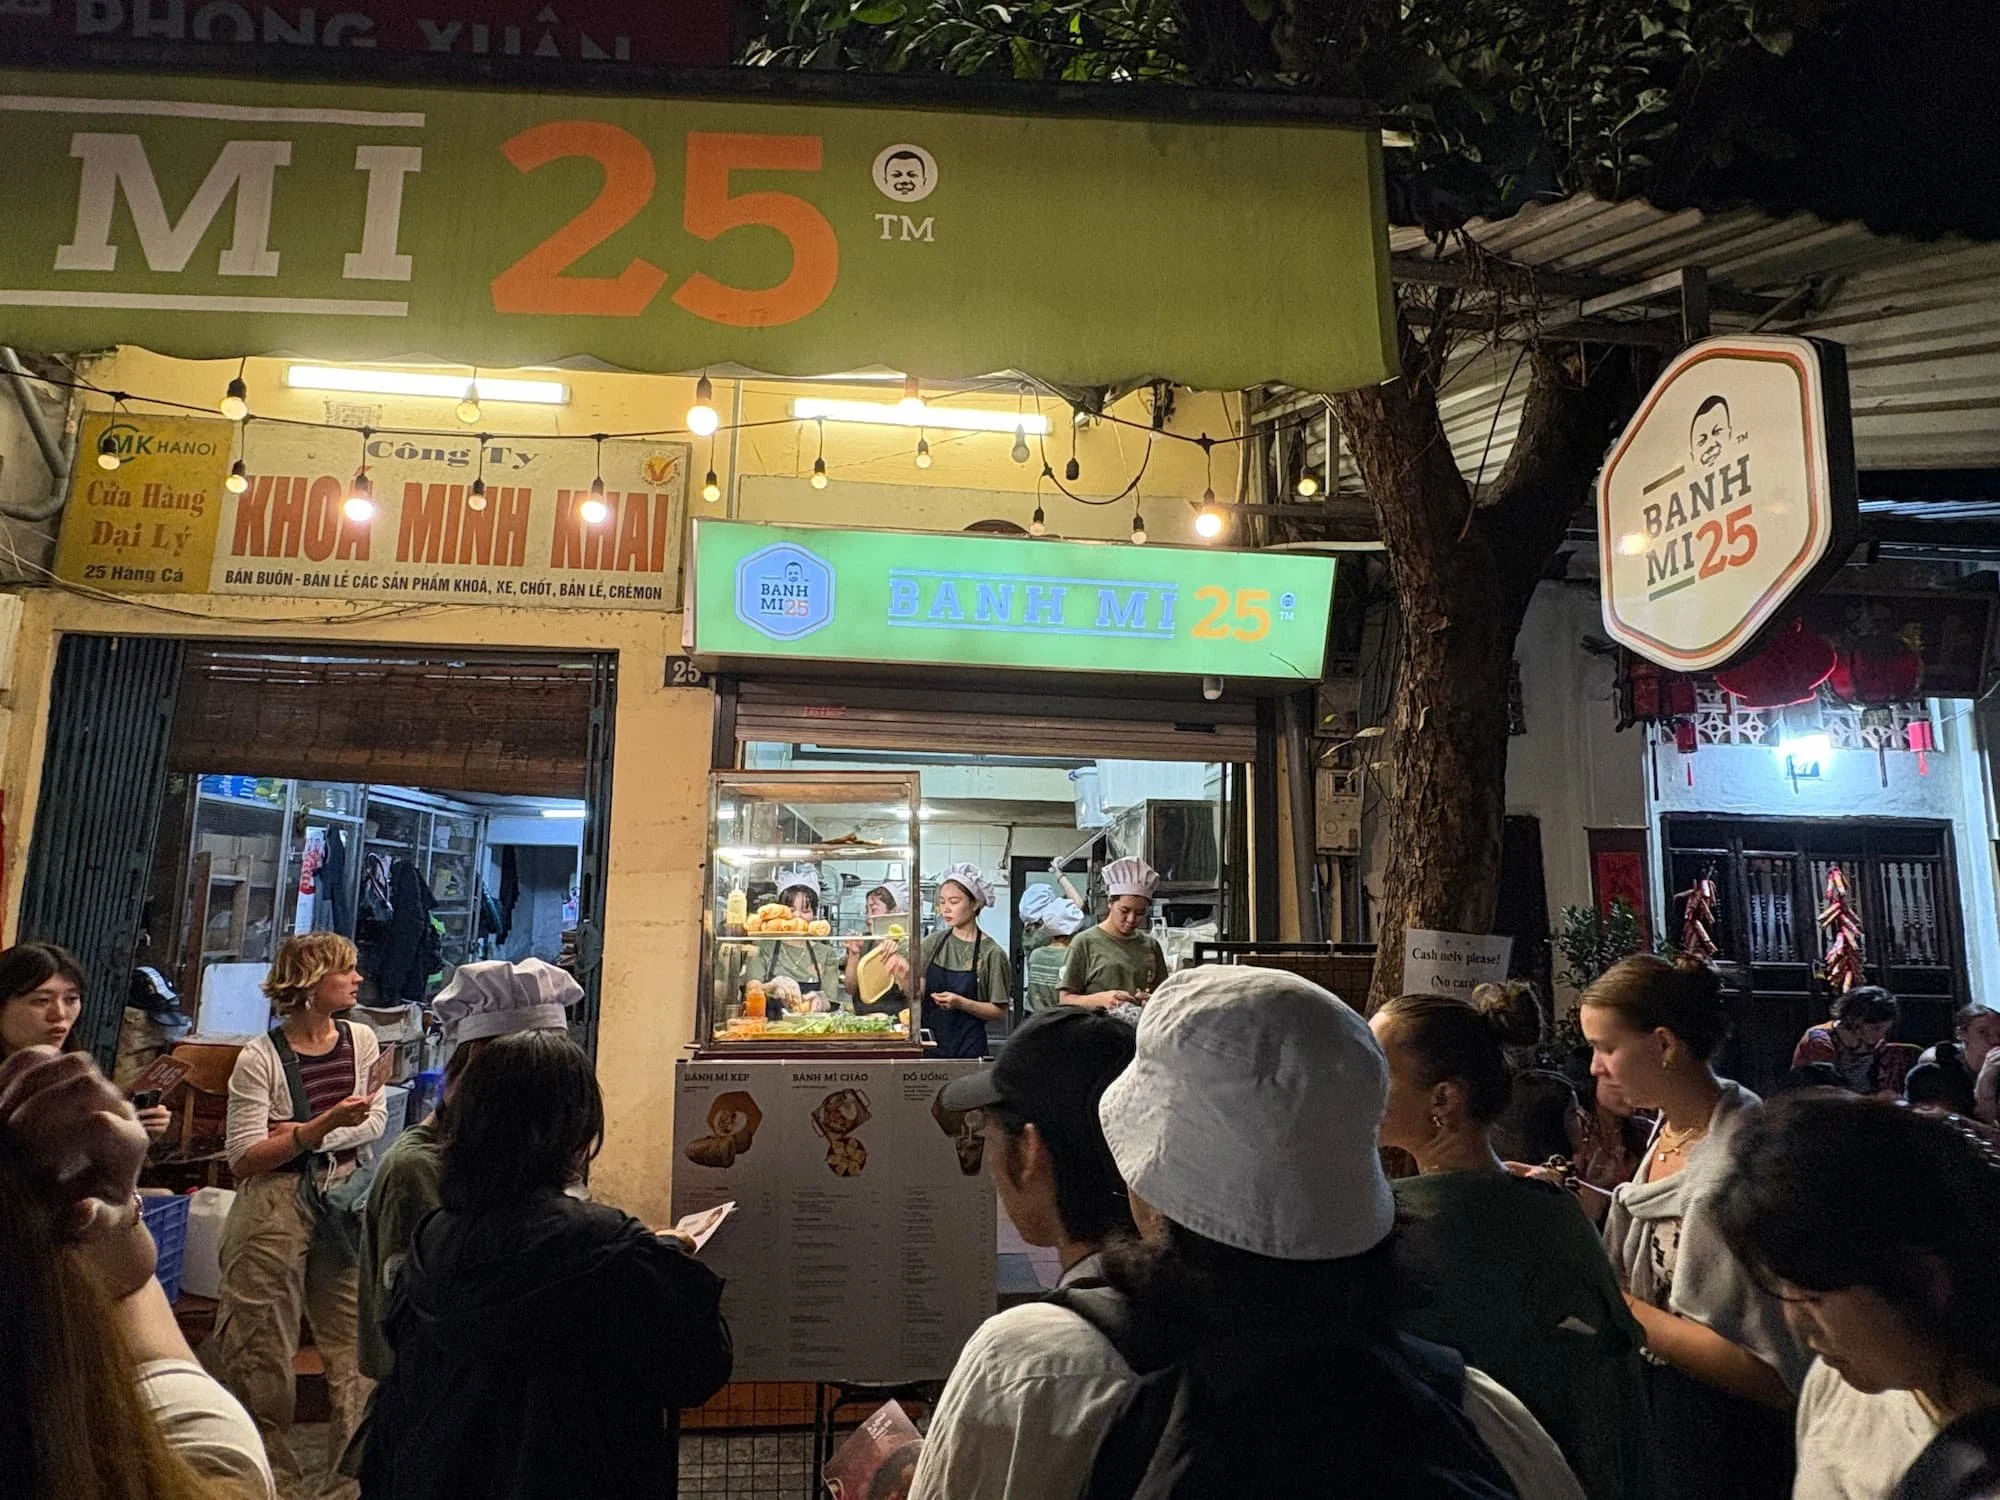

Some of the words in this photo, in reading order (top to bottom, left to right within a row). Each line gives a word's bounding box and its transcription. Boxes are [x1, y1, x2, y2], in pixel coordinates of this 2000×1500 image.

[53, 132, 422, 280] MI
[490, 119, 839, 327] 25
[874, 213, 935, 242] TM
[157, 440, 217, 456] HANOI
[367, 440, 471, 468] Công
[482, 446, 540, 470] Ty
[1643, 454, 1752, 539] BANH
[231, 466, 373, 562] KHOÁ
[395, 481, 532, 567] MINH
[550, 489, 669, 573] KHAI
[150, 523, 193, 557] Lý
[1696, 503, 1758, 581] 25
[84, 564, 106, 579] 25
[760, 583, 809, 597] BANH
[784, 600, 809, 617] 25
[888, 578, 1067, 624] BANH
[1096, 590, 1178, 629] MI
[1190, 586, 1272, 642] 25
[672, 660, 701, 683] 25
[1412, 947, 1438, 961] Cash
[1440, 951, 1464, 966] only
[1465, 951, 1501, 967] please!
[1431, 974, 1450, 989] (No
